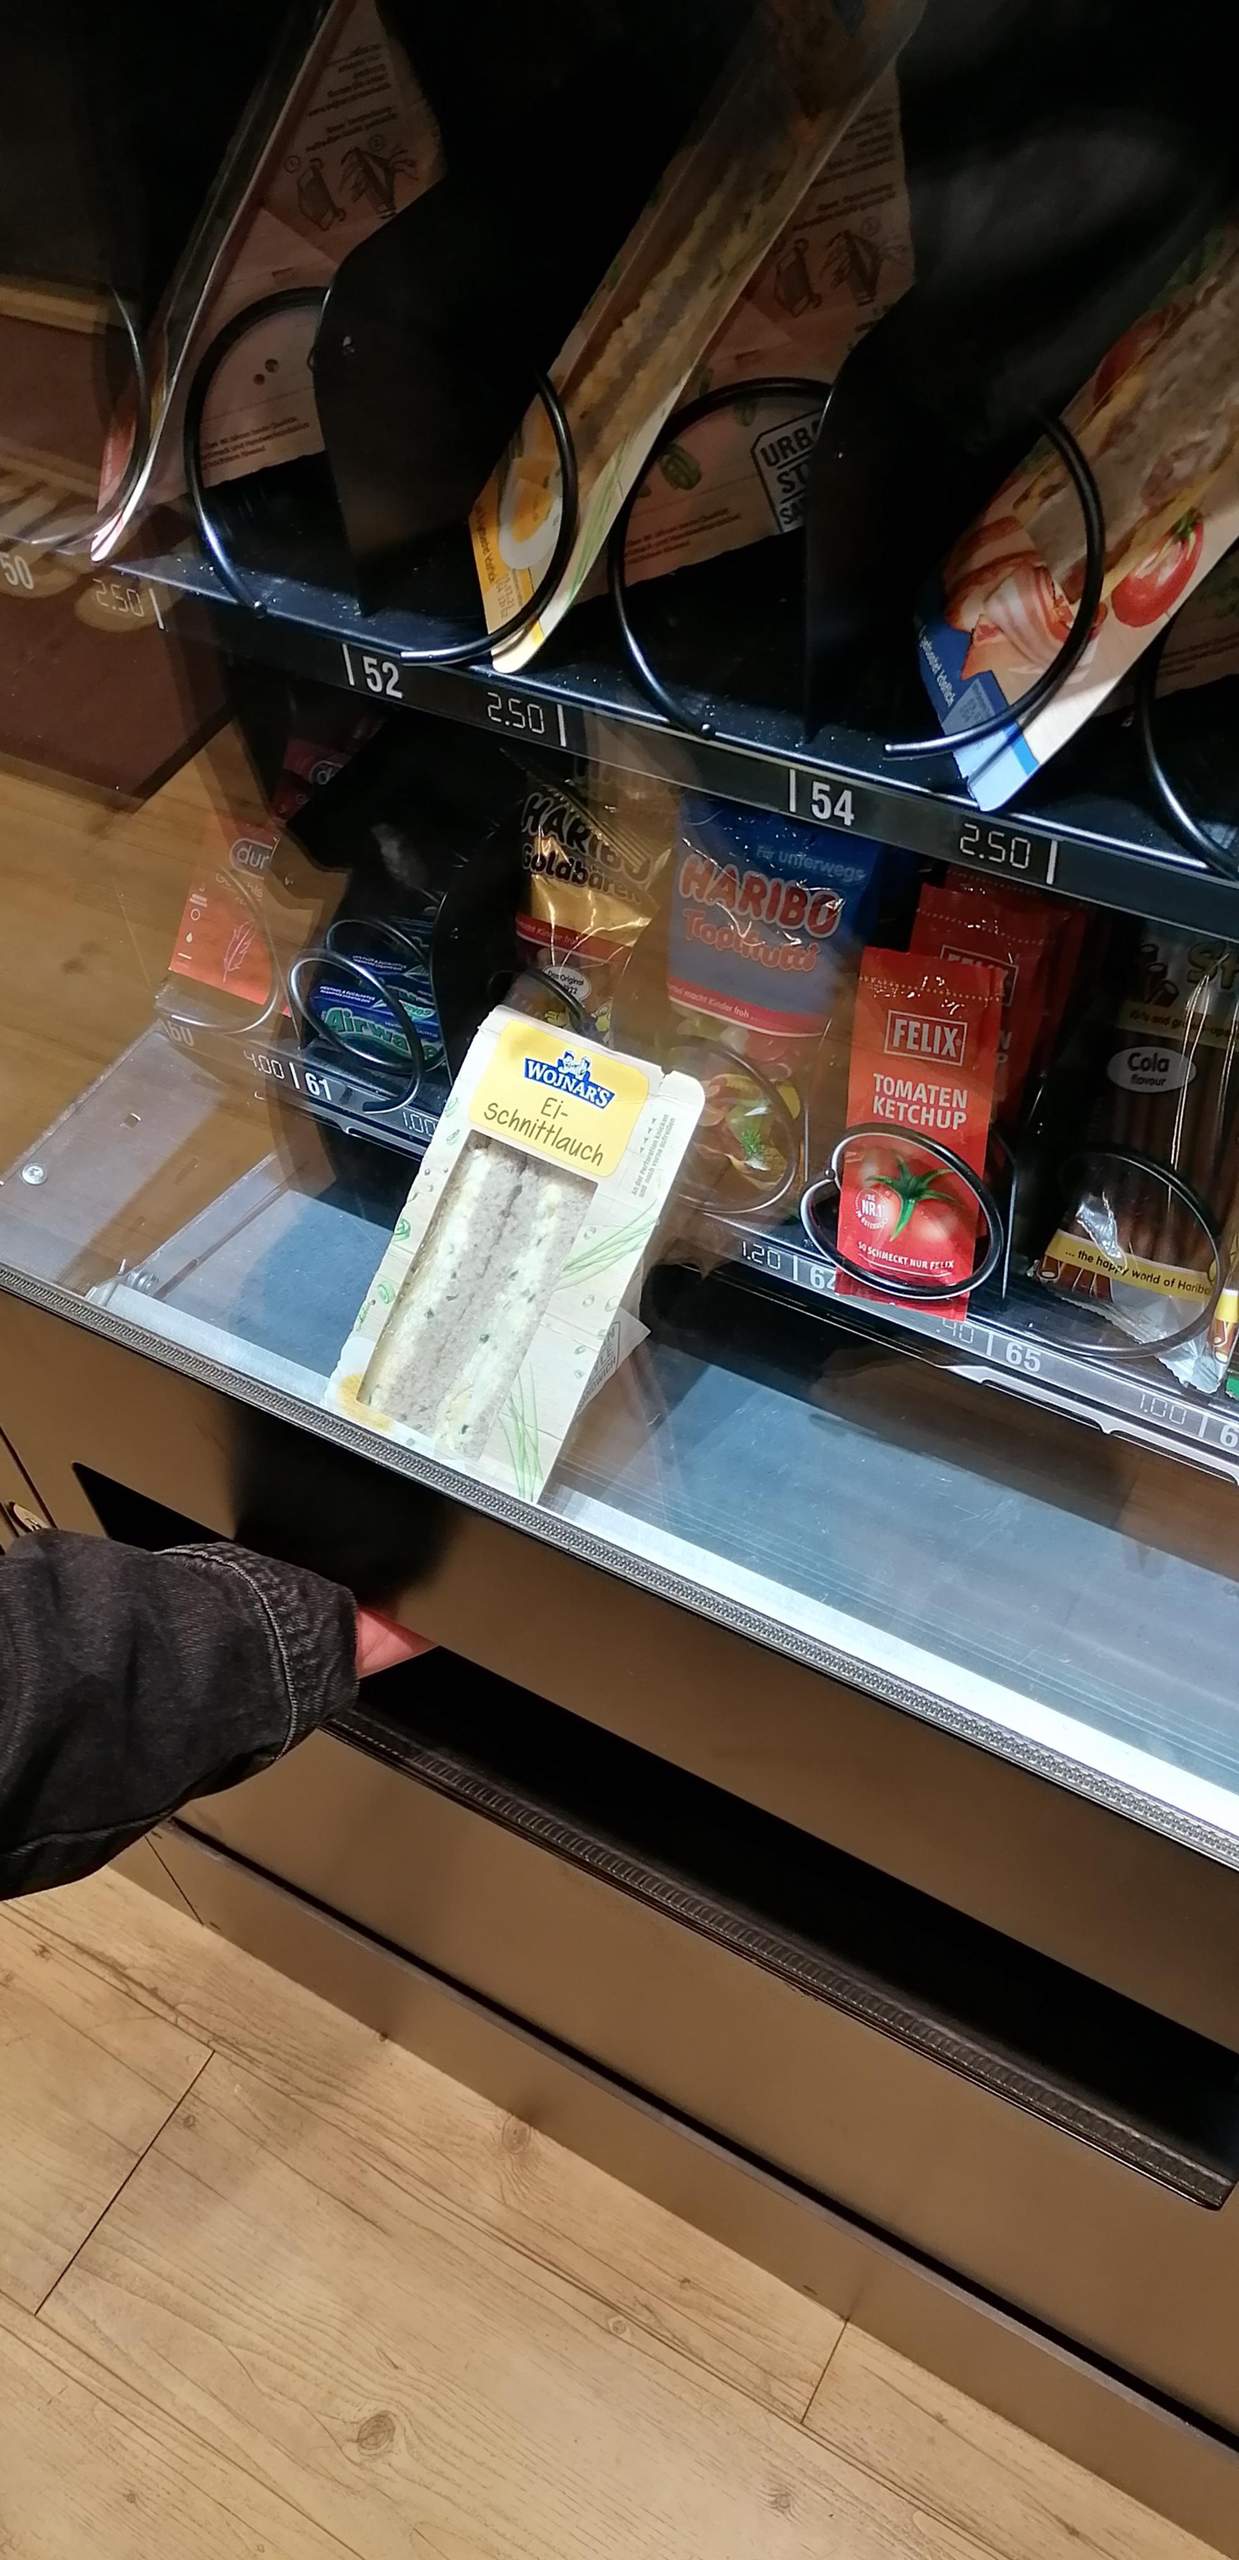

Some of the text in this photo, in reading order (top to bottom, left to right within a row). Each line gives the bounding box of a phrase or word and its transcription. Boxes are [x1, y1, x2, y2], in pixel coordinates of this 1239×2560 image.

[0, 551, 34, 590] 50
[92, 578, 144, 618] 2.50
[362, 656, 403, 699] 52
[487, 692, 545, 735] 2.50
[811, 781, 855, 827] 54
[237, 844, 271, 870] dur
[959, 823, 1031, 870] 2.50
[679, 854, 844, 938] HARIBO
[893, 1018, 958, 1057] FELIX
[244, 1049, 286, 1080] 4.00
[1127, 1052, 1170, 1073] Cola
[1130, 1073, 1167, 1087] flavour
[305, 1071, 333, 1101] 61
[526, 1060, 611, 1108] WOJNAR'S
[873, 1073, 969, 1109] TOMATEN
[540, 1096, 569, 1120] Ei-
[872, 1097, 968, 1130] KETCHUP
[483, 1102, 605, 1168] Schnittlauch
[741, 1241, 781, 1270] 1.20
[867, 1246, 908, 1266] SCHMECKT
[909, 1259, 929, 1270] NUR
[929, 1260, 955, 1271] FELIX
[1077, 1249, 1095, 1264] the
[1131, 1268, 1161, 1286] world
[1163, 1276, 1176, 1288] of
[1005, 1341, 1051, 1373] 65
[1139, 1393, 1188, 1426] 1.00
